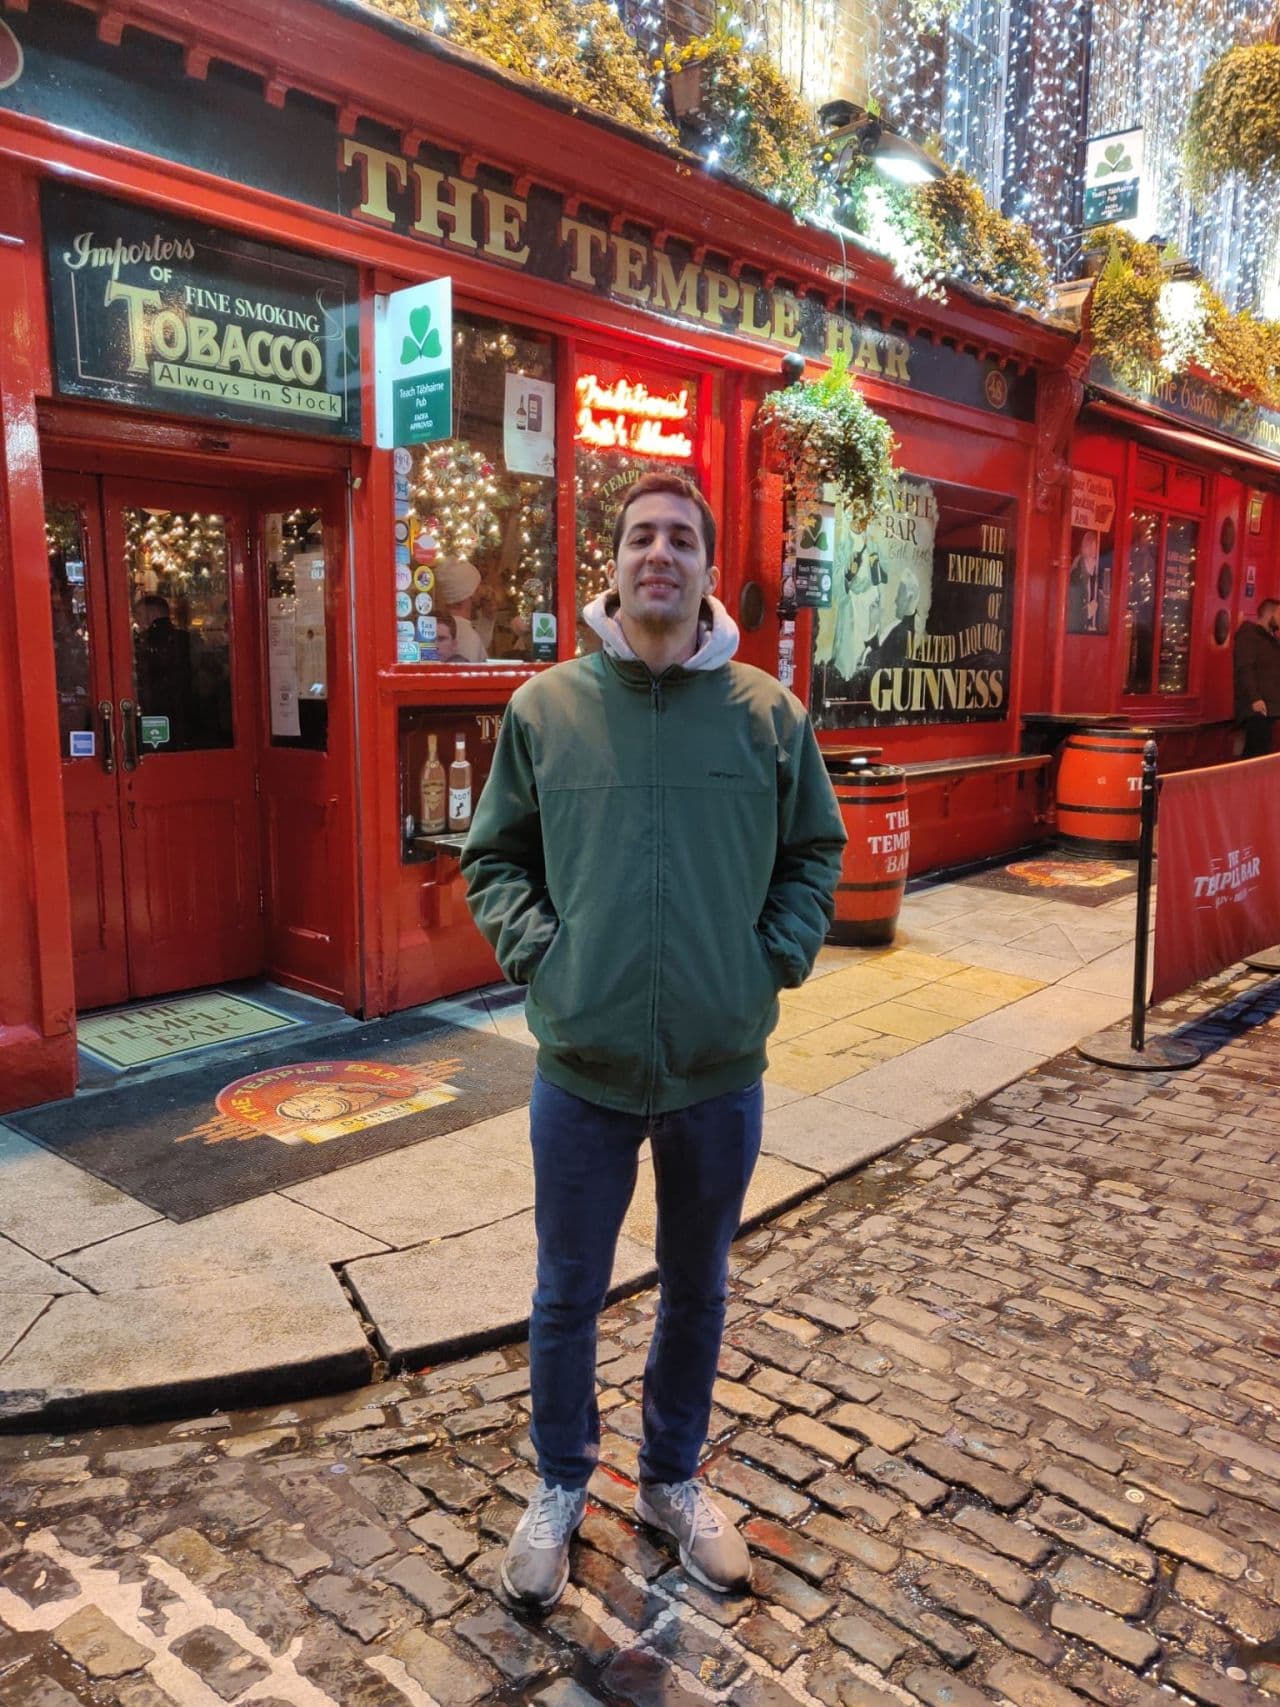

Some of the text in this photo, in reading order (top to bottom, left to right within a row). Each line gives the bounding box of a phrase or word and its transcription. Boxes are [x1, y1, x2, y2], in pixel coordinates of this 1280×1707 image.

[63, 231, 195, 280] Importers
[340, 138, 912, 382] THE TEMPLE BAR
[150, 266, 172, 283] OF
[184, 285, 321, 334] FINE SMOKING
[104, 280, 323, 387] TOBACCO
[158, 364, 338, 413] Always in Stock
[400, 386, 416, 399] Teach
[415, 397, 427, 408] Pub
[603, 468, 641, 498] TEMPL
[884, 514, 919, 545] BAR
[981, 524, 1006, 555] THE
[948, 553, 1004, 588] EMPEROR
[987, 592, 1003, 620] OF
[905, 629, 956, 664] MALTED
[870, 667, 1003, 712] GUINNESS
[1240, 856, 1261, 882] BAR
[94, 1002, 254, 1045] TEMPLE
[106, 1002, 194, 1025] THE
[153, 1021, 244, 1048] BAR
[231, 1063, 400, 1122] THE TEMPLE BAR
[340, 1100, 412, 1128] DUBLIN
